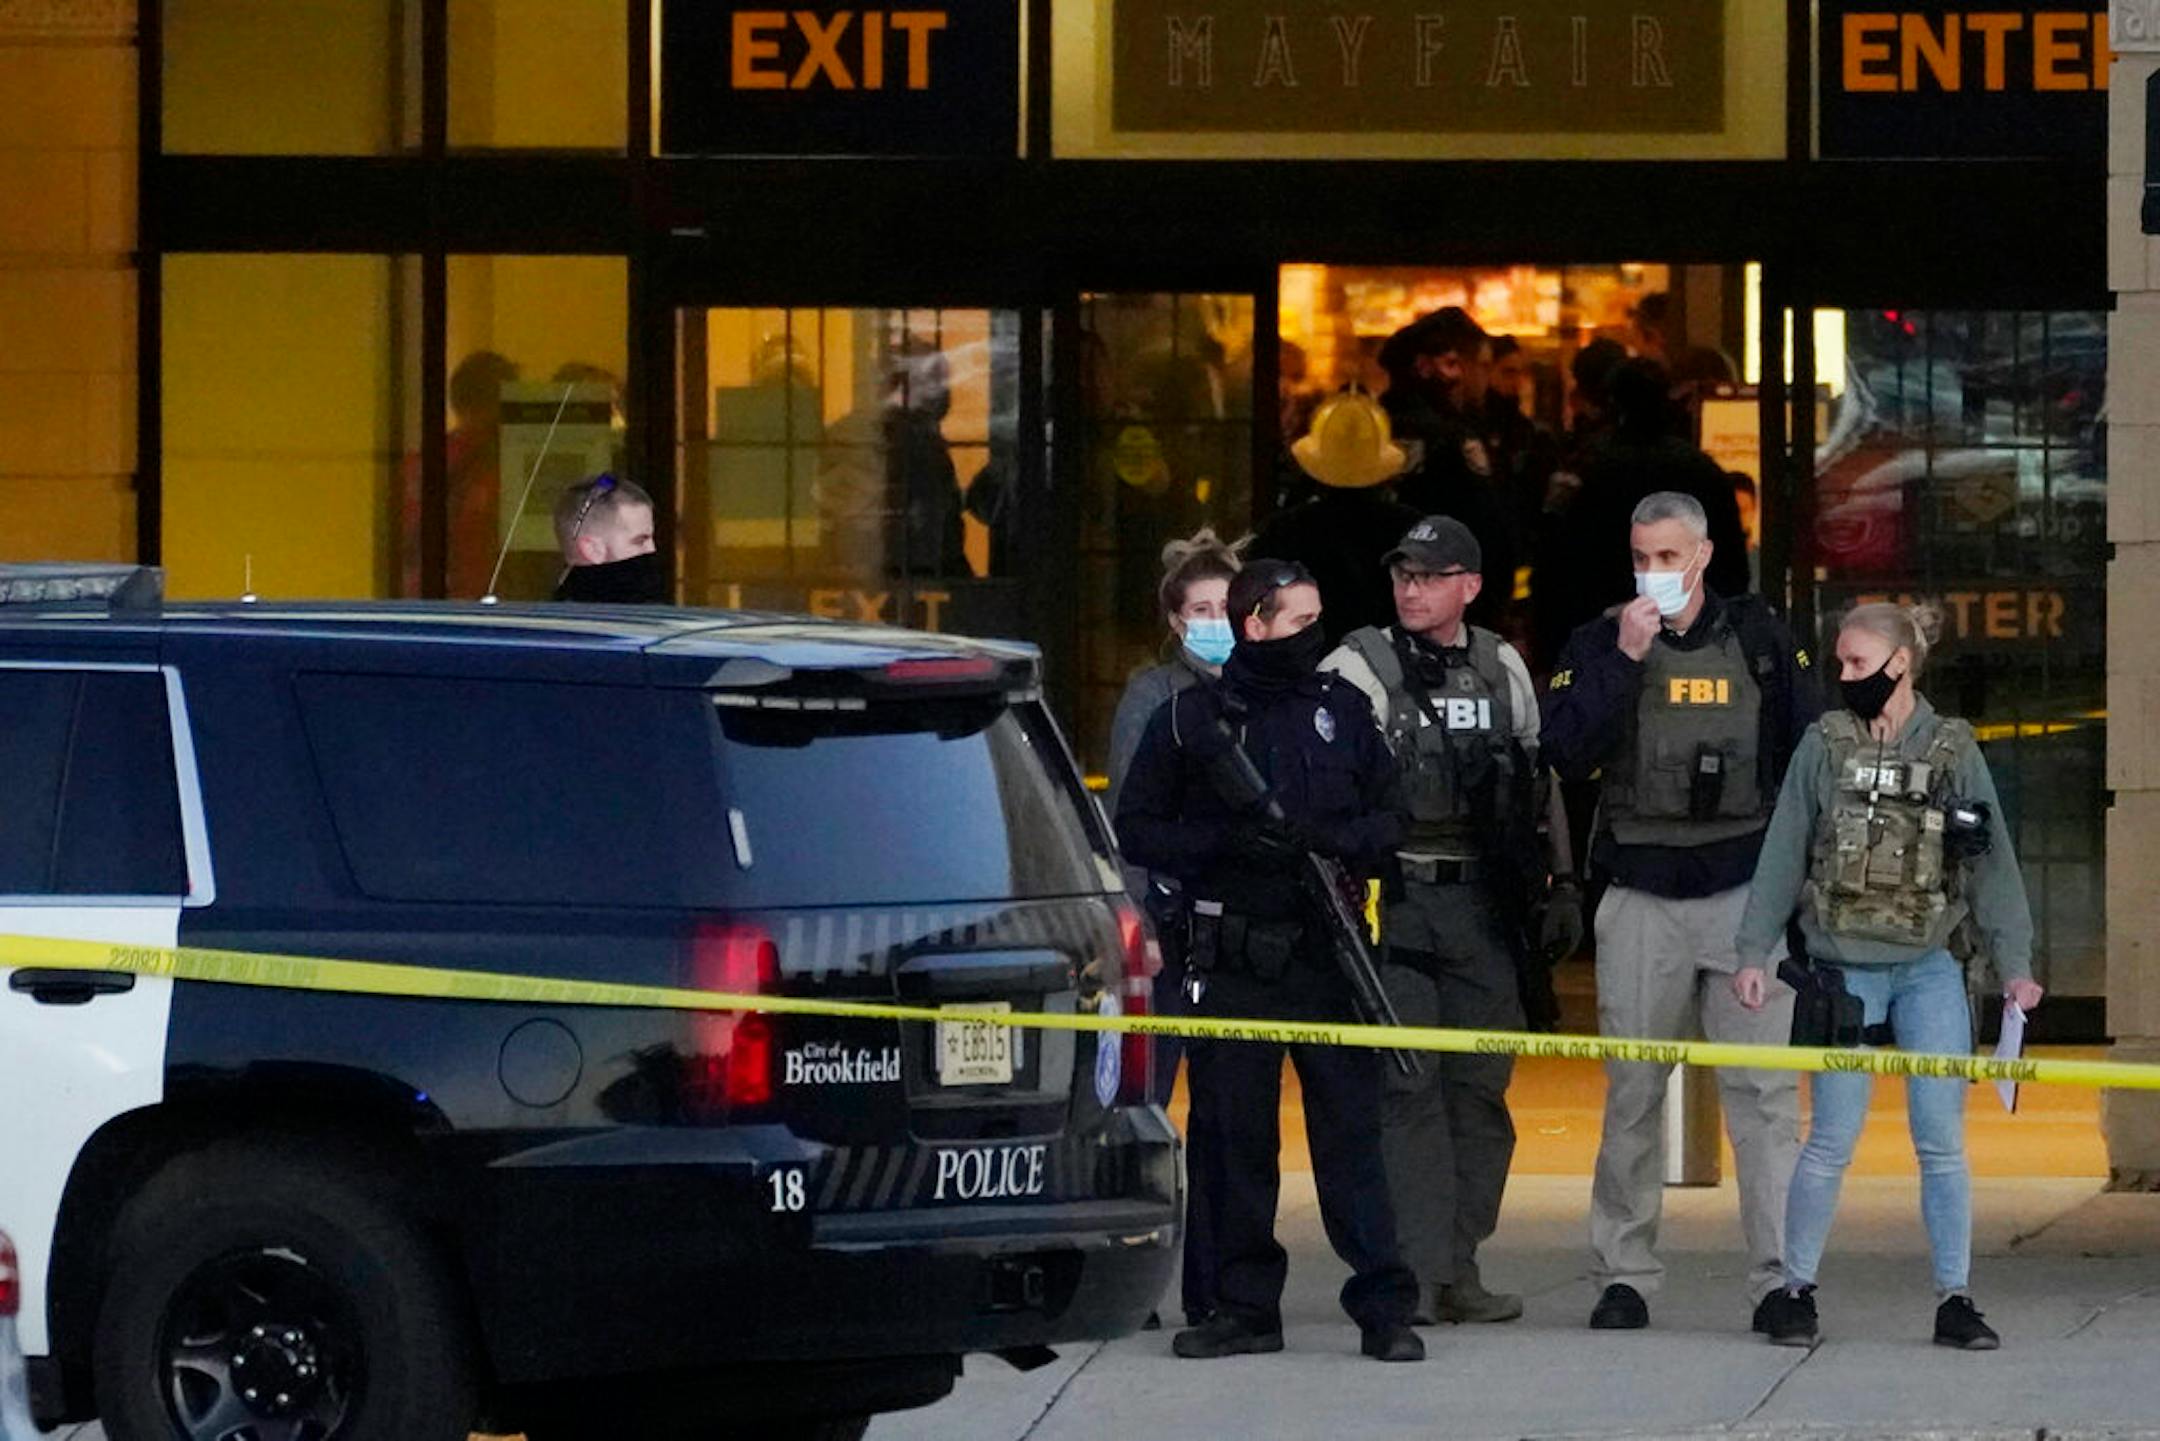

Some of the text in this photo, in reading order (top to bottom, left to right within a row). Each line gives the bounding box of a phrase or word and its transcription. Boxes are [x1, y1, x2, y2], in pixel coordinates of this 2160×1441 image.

[730, 10, 947, 91] EXIT
[1167, 14, 1675, 87] MAYFAIR
[1668, 677, 1729, 705] FBI
[1855, 766, 1895, 786] FBI
[784, 1047, 901, 1085] Brookfield
[803, 1040, 842, 1059] City of
[768, 1168, 806, 1212] 18
[933, 1145, 1047, 1200] POLICE
